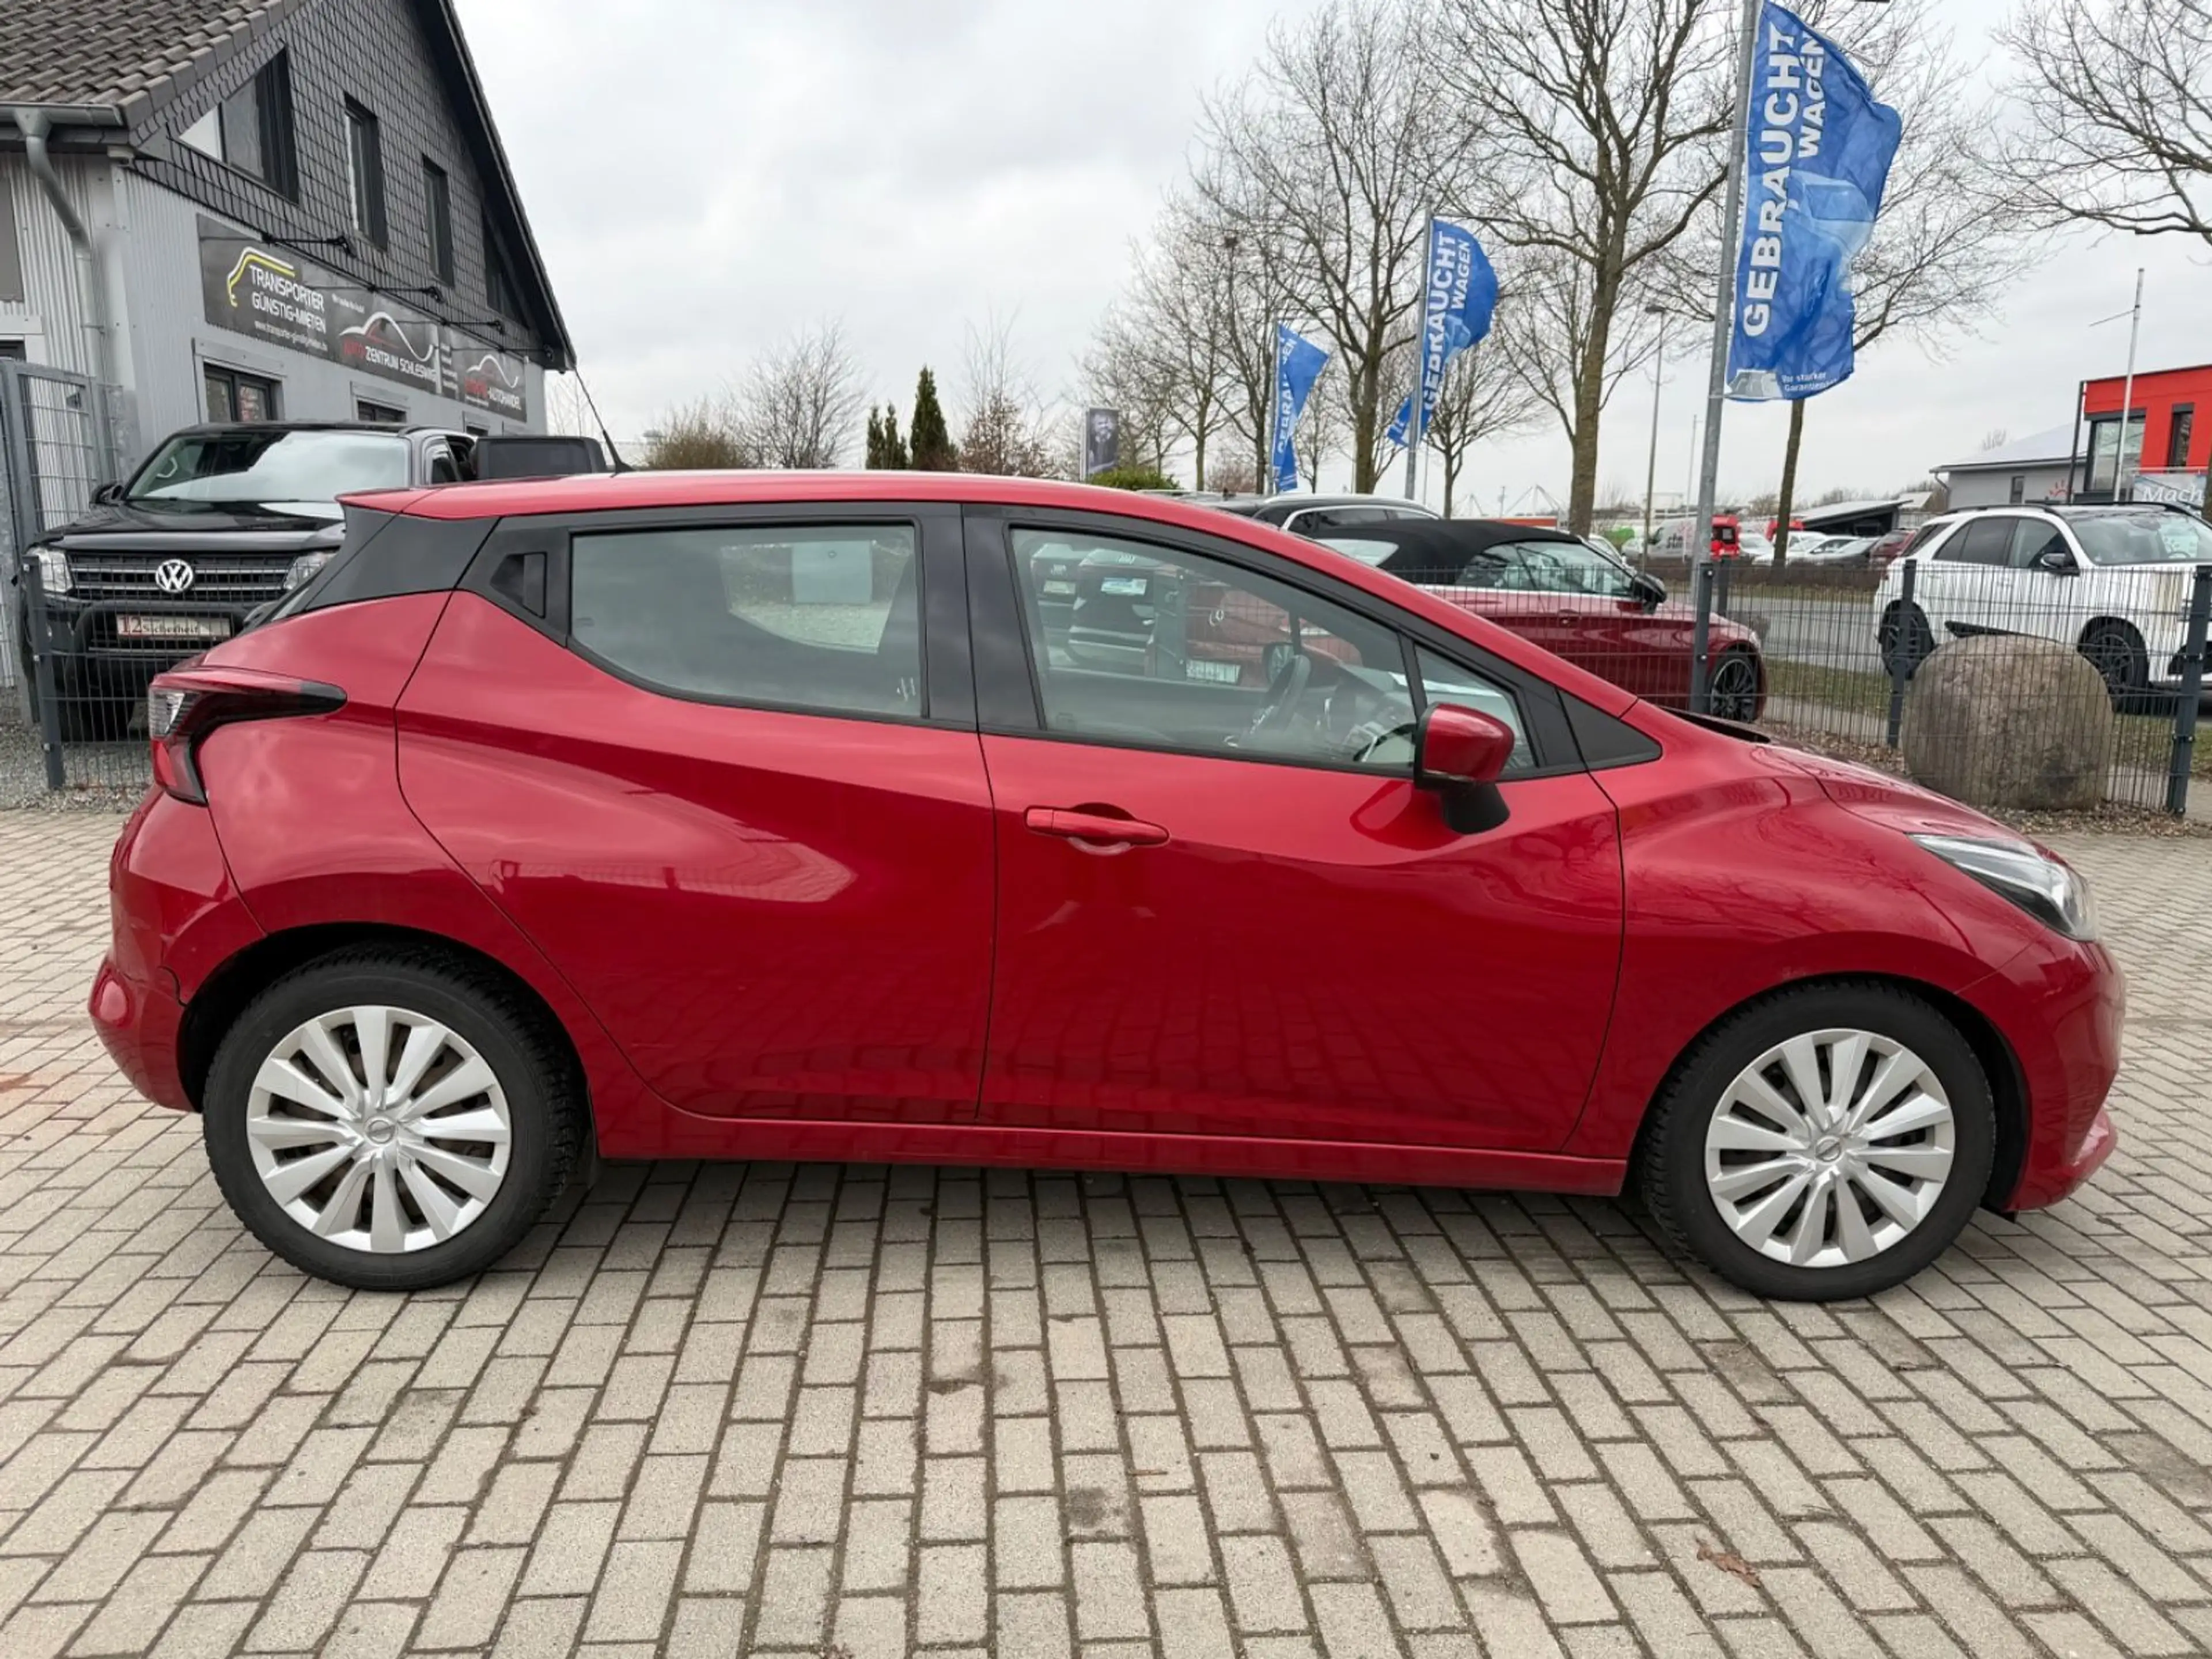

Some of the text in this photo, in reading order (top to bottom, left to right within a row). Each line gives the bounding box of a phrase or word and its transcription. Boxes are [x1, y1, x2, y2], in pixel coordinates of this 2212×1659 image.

[1798, 31, 1825, 158] WAGEN
[1743, 21, 1801, 336] GEBRAUCHT
[249, 265, 325, 313] TRANSPORTER
[1451, 240, 1471, 309] WAGEN
[252, 291, 327, 334] GÜNSTIG-MIETEN
[2142, 484, 2203, 503] Mach
[156, 560, 192, 592] VW
[119, 615, 142, 633] 12
